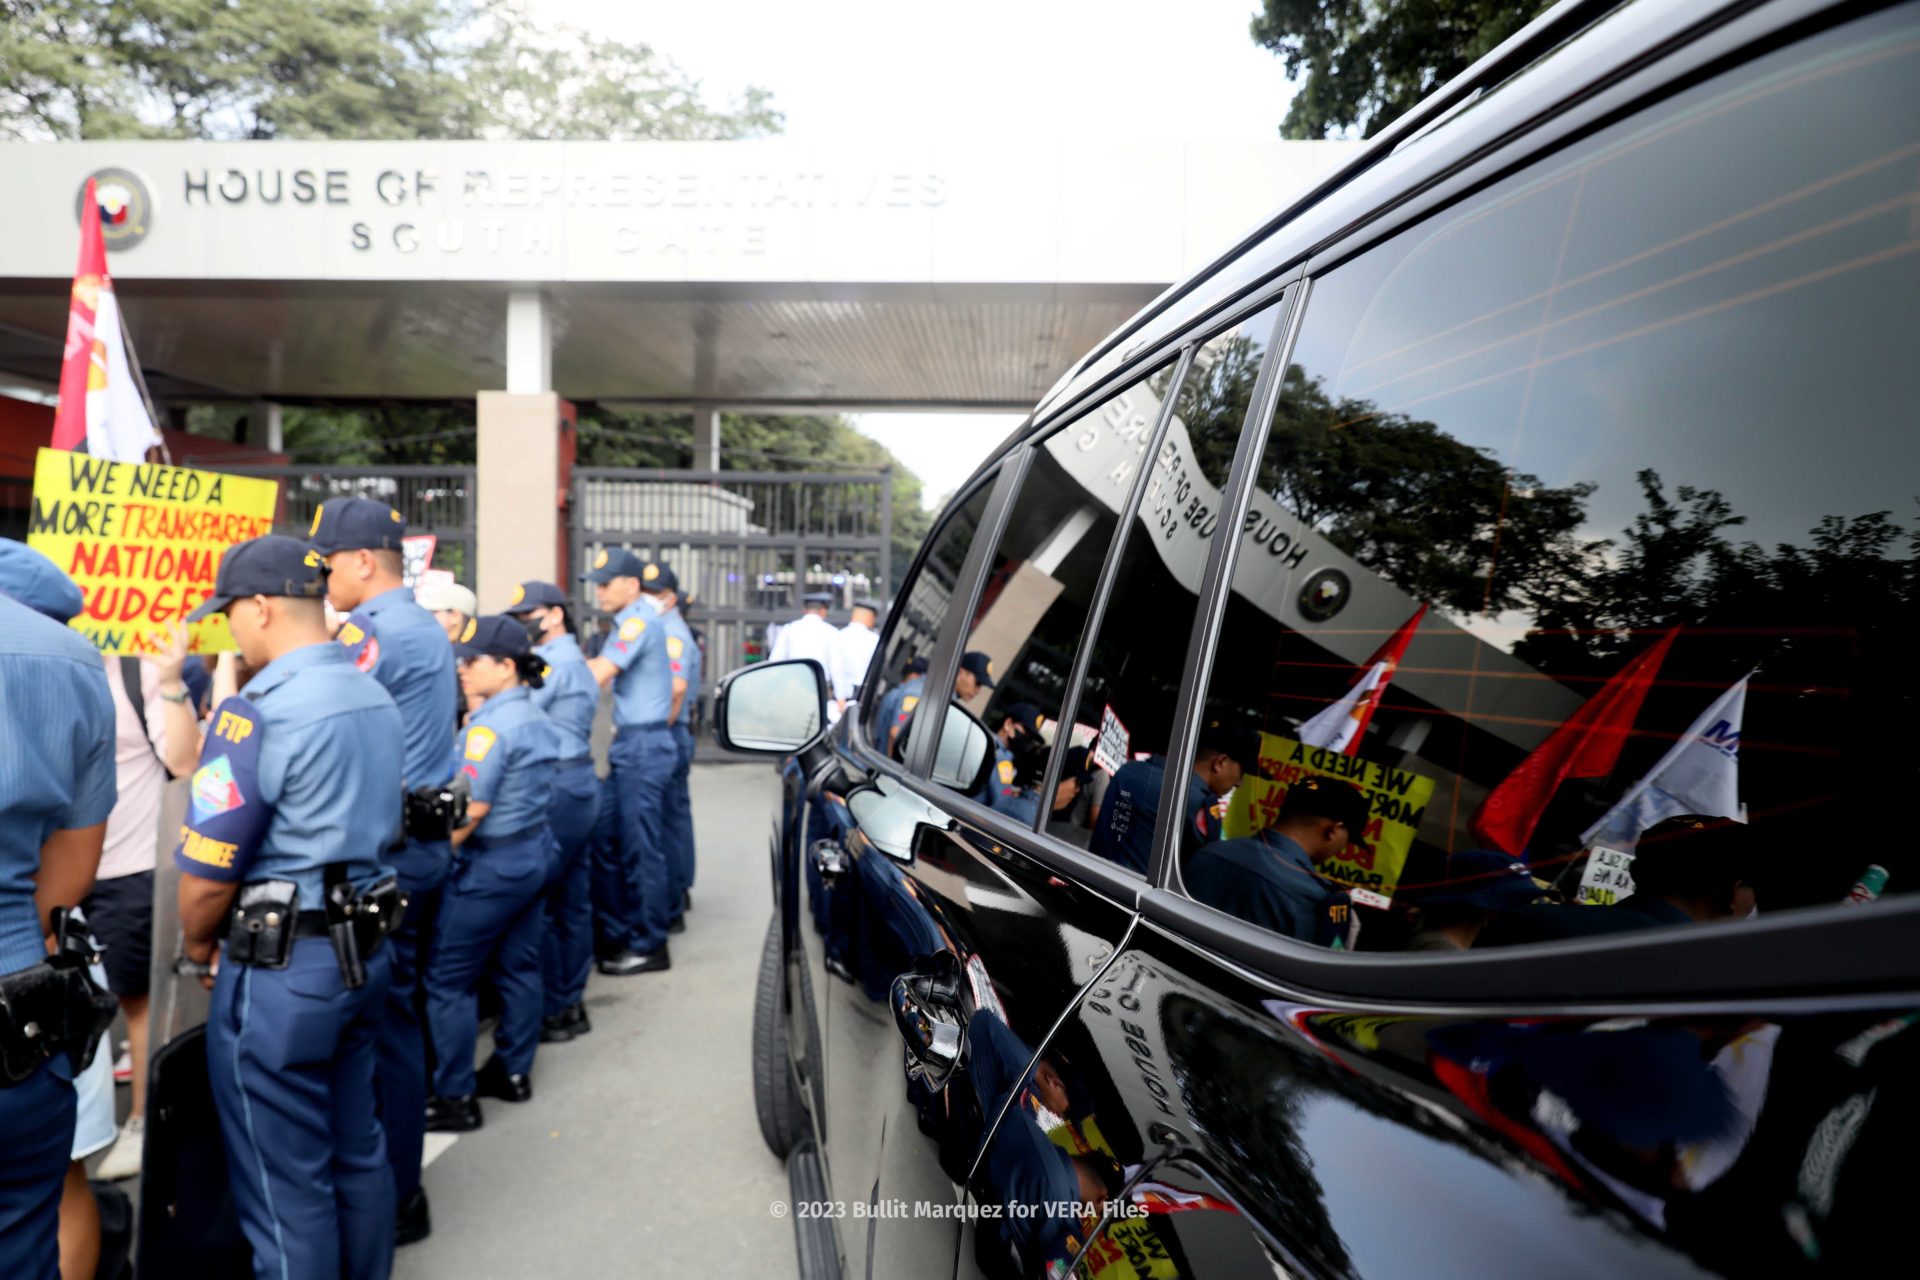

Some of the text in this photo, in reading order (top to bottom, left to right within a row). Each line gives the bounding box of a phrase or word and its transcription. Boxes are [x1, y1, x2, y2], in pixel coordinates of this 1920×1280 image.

[184, 169, 351, 206] HOUSE
[376, 169, 438, 206] OF
[70, 456, 222, 505] WE NEED A
[30, 497, 273, 545] MORE TRANSPARENT
[70, 541, 222, 583] NATIONA
[215, 710, 254, 744] FTP
